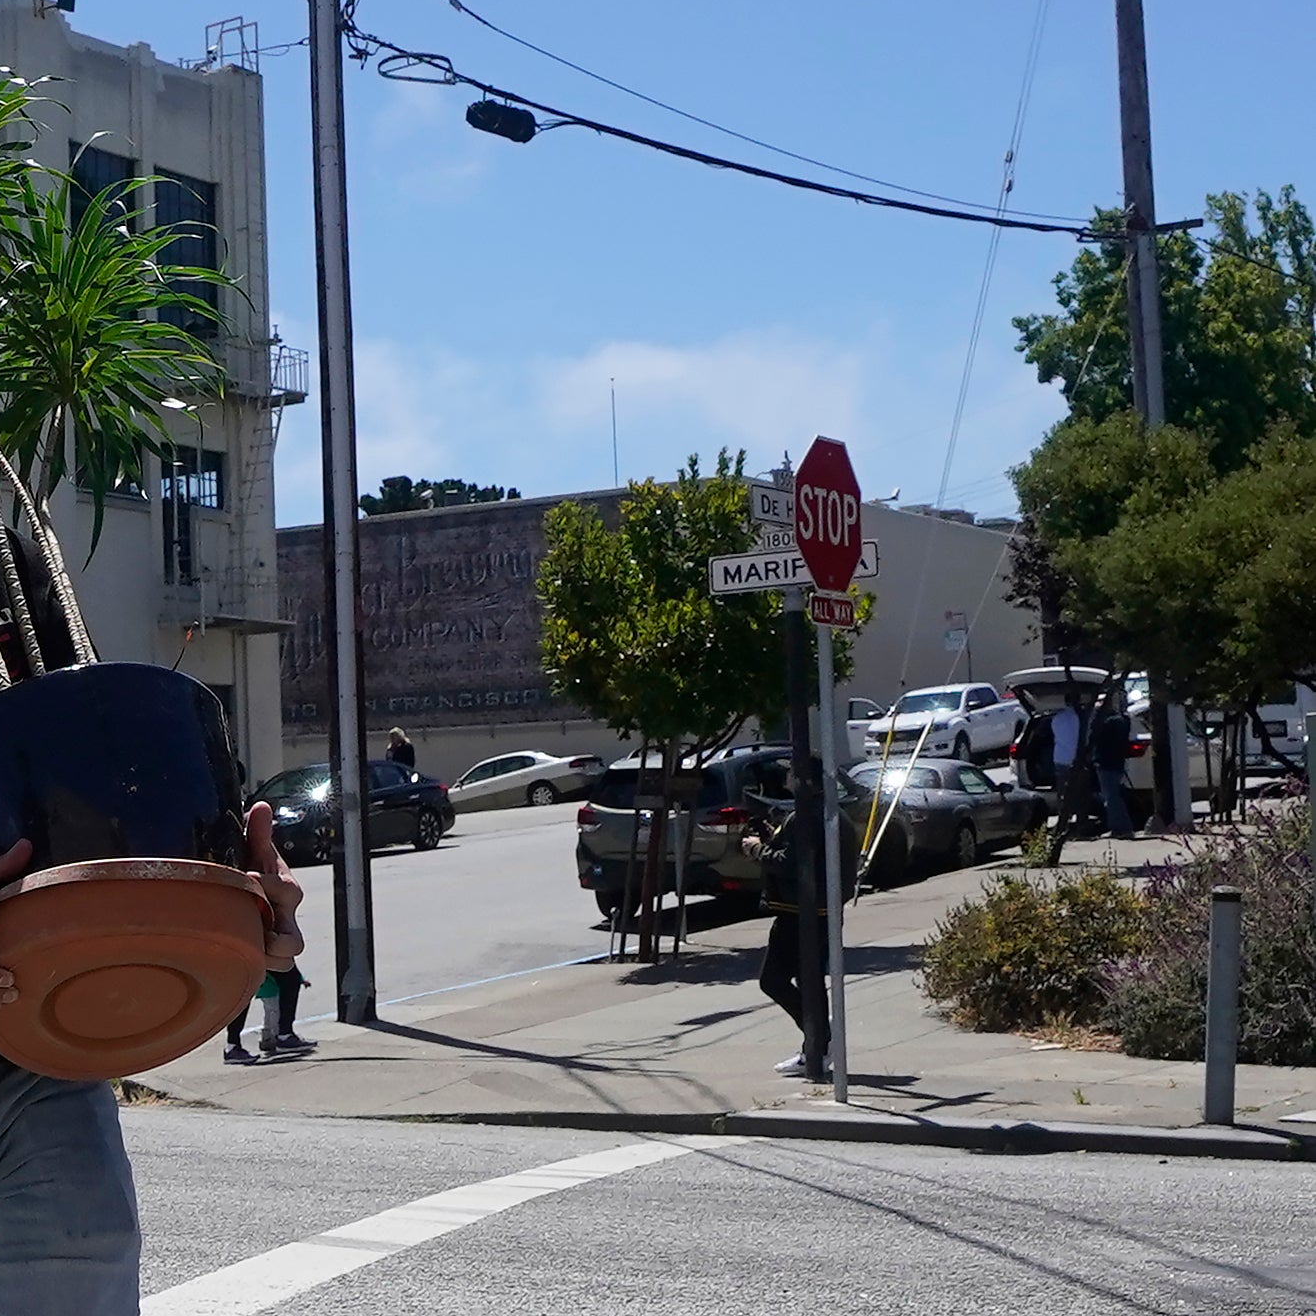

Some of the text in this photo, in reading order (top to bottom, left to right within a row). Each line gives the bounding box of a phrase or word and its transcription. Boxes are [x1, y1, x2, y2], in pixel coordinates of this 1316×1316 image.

[799, 483, 858, 547] STOP
[766, 533, 794, 548] 180
[723, 557, 869, 585] MARIP
[814, 601, 851, 622] ALL WAY
